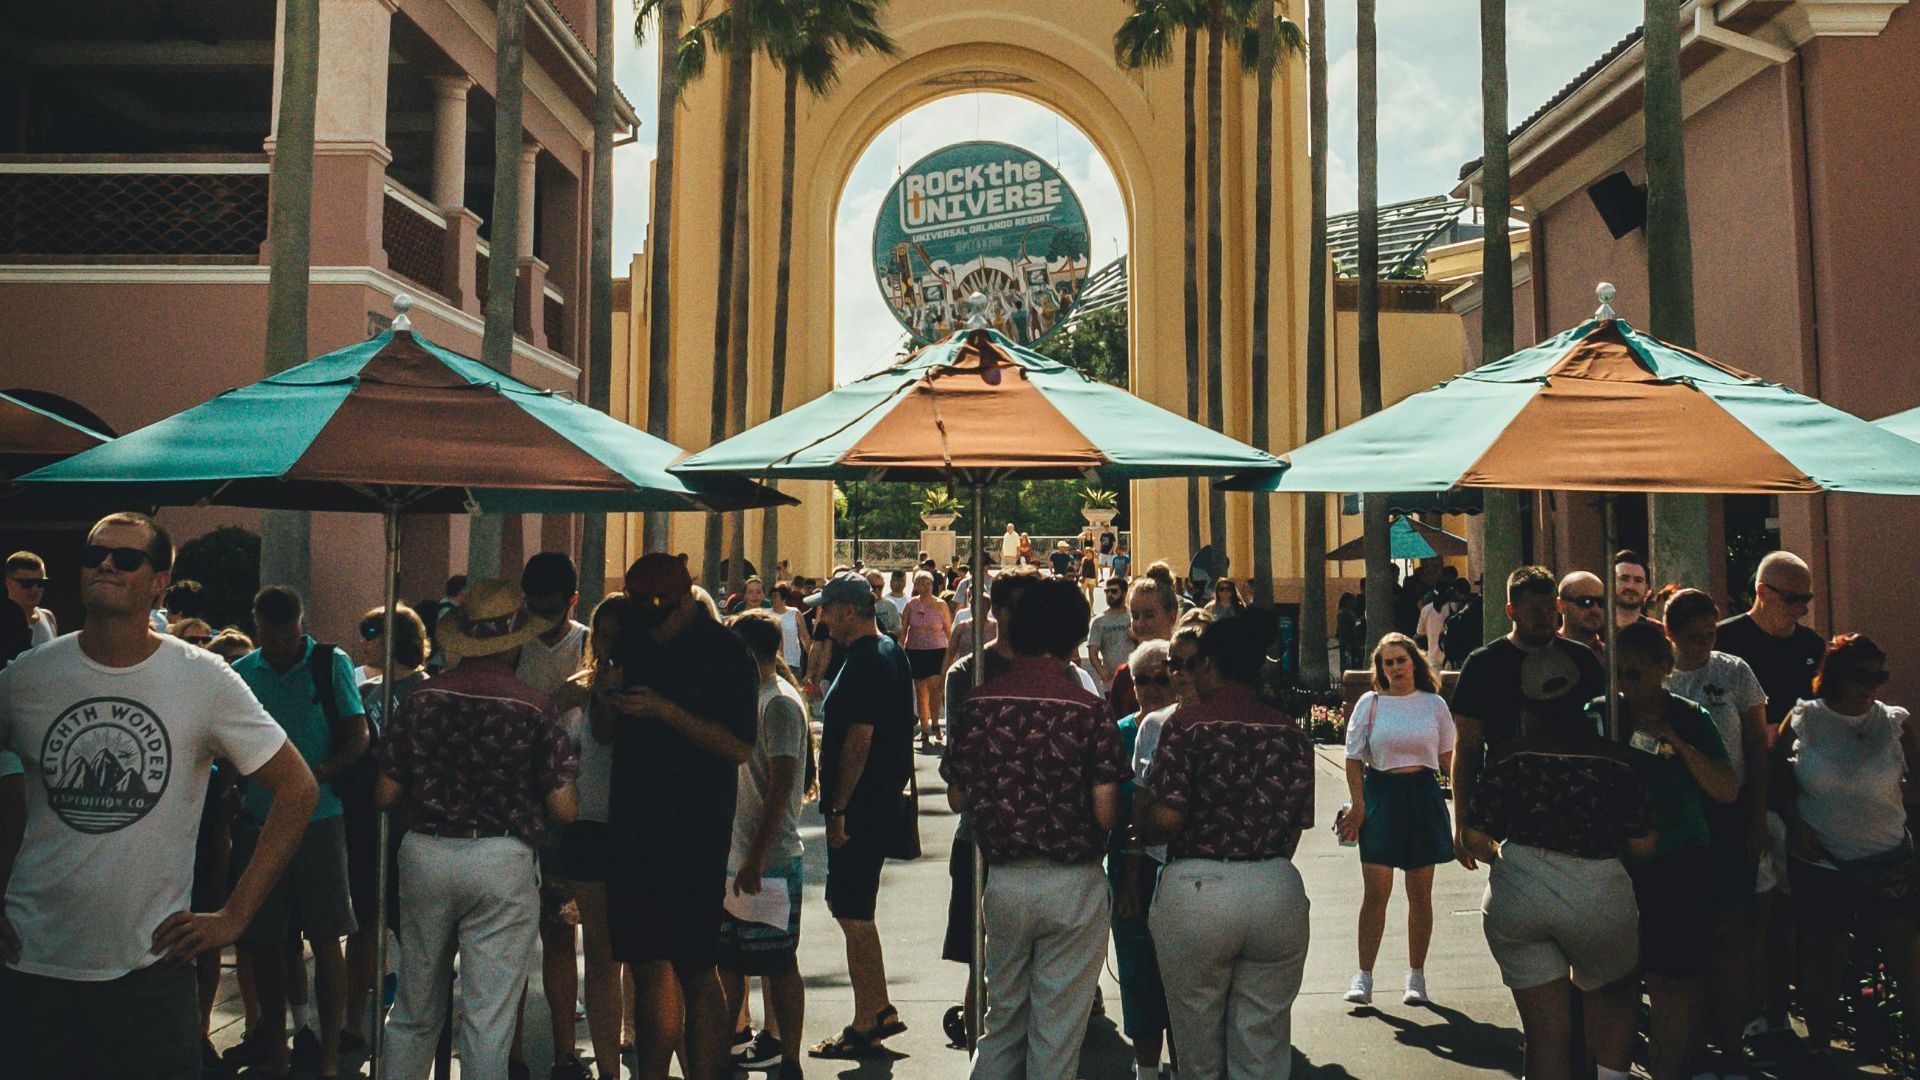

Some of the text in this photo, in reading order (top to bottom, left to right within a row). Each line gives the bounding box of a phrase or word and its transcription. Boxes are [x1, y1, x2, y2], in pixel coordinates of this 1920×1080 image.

[907, 179, 1062, 225] UNIVERSE
[912, 213, 1051, 243] UNIVERSAL ORLANDO RESORT
[45, 705, 164, 780] EIGHTH WONDER
